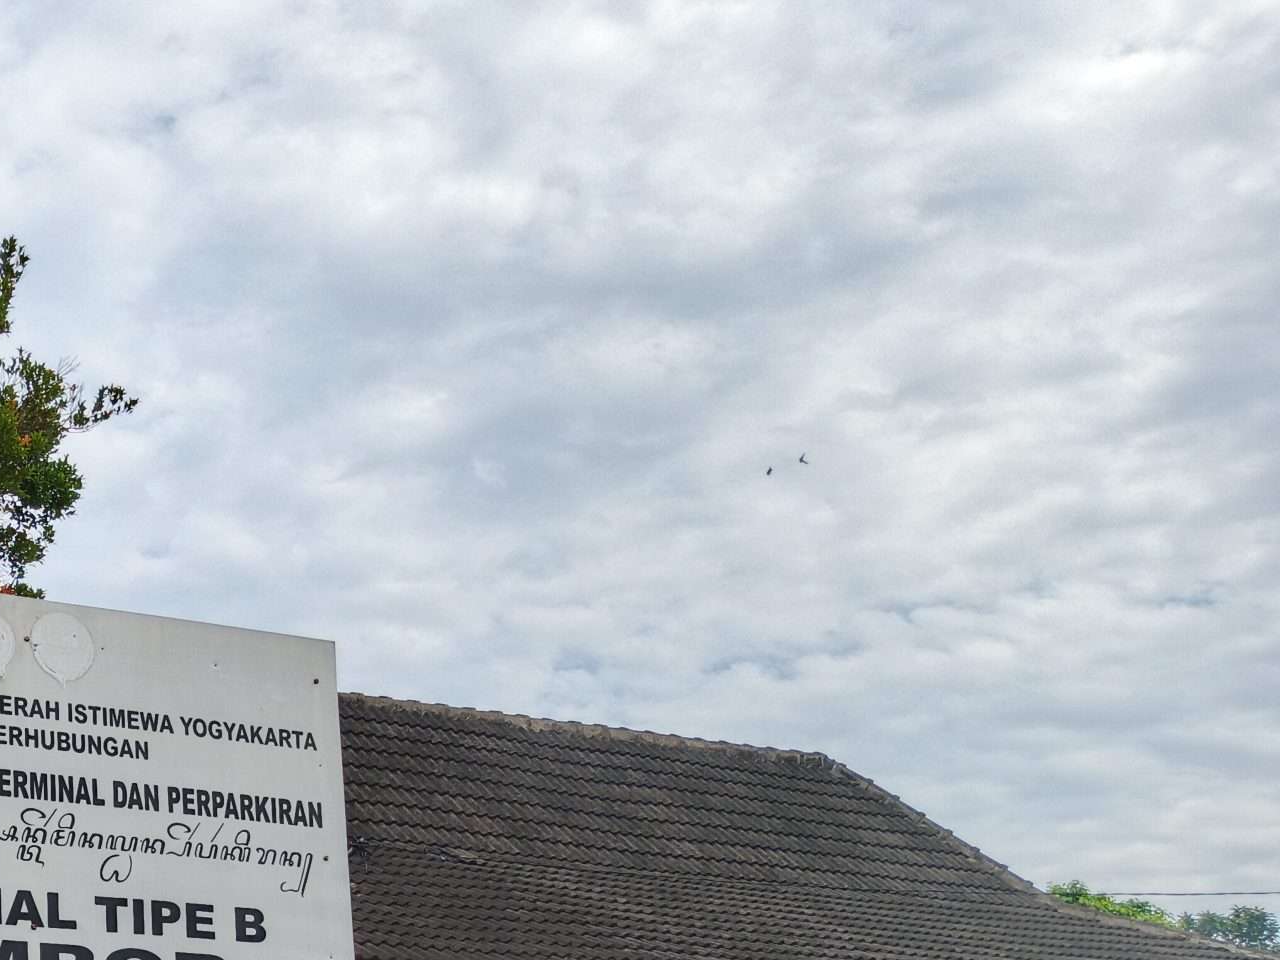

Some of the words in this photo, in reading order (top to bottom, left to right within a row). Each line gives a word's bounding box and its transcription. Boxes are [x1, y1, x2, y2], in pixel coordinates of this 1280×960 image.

[67, 702, 175, 735] ISTIMEWA
[179, 716, 318, 752] YOGYAKARTA
[112, 780, 160, 812] DAN
[167, 786, 323, 829] PERPARKIRAN
[94, 895, 216, 941] TIPE
[234, 906, 267, 943] B
